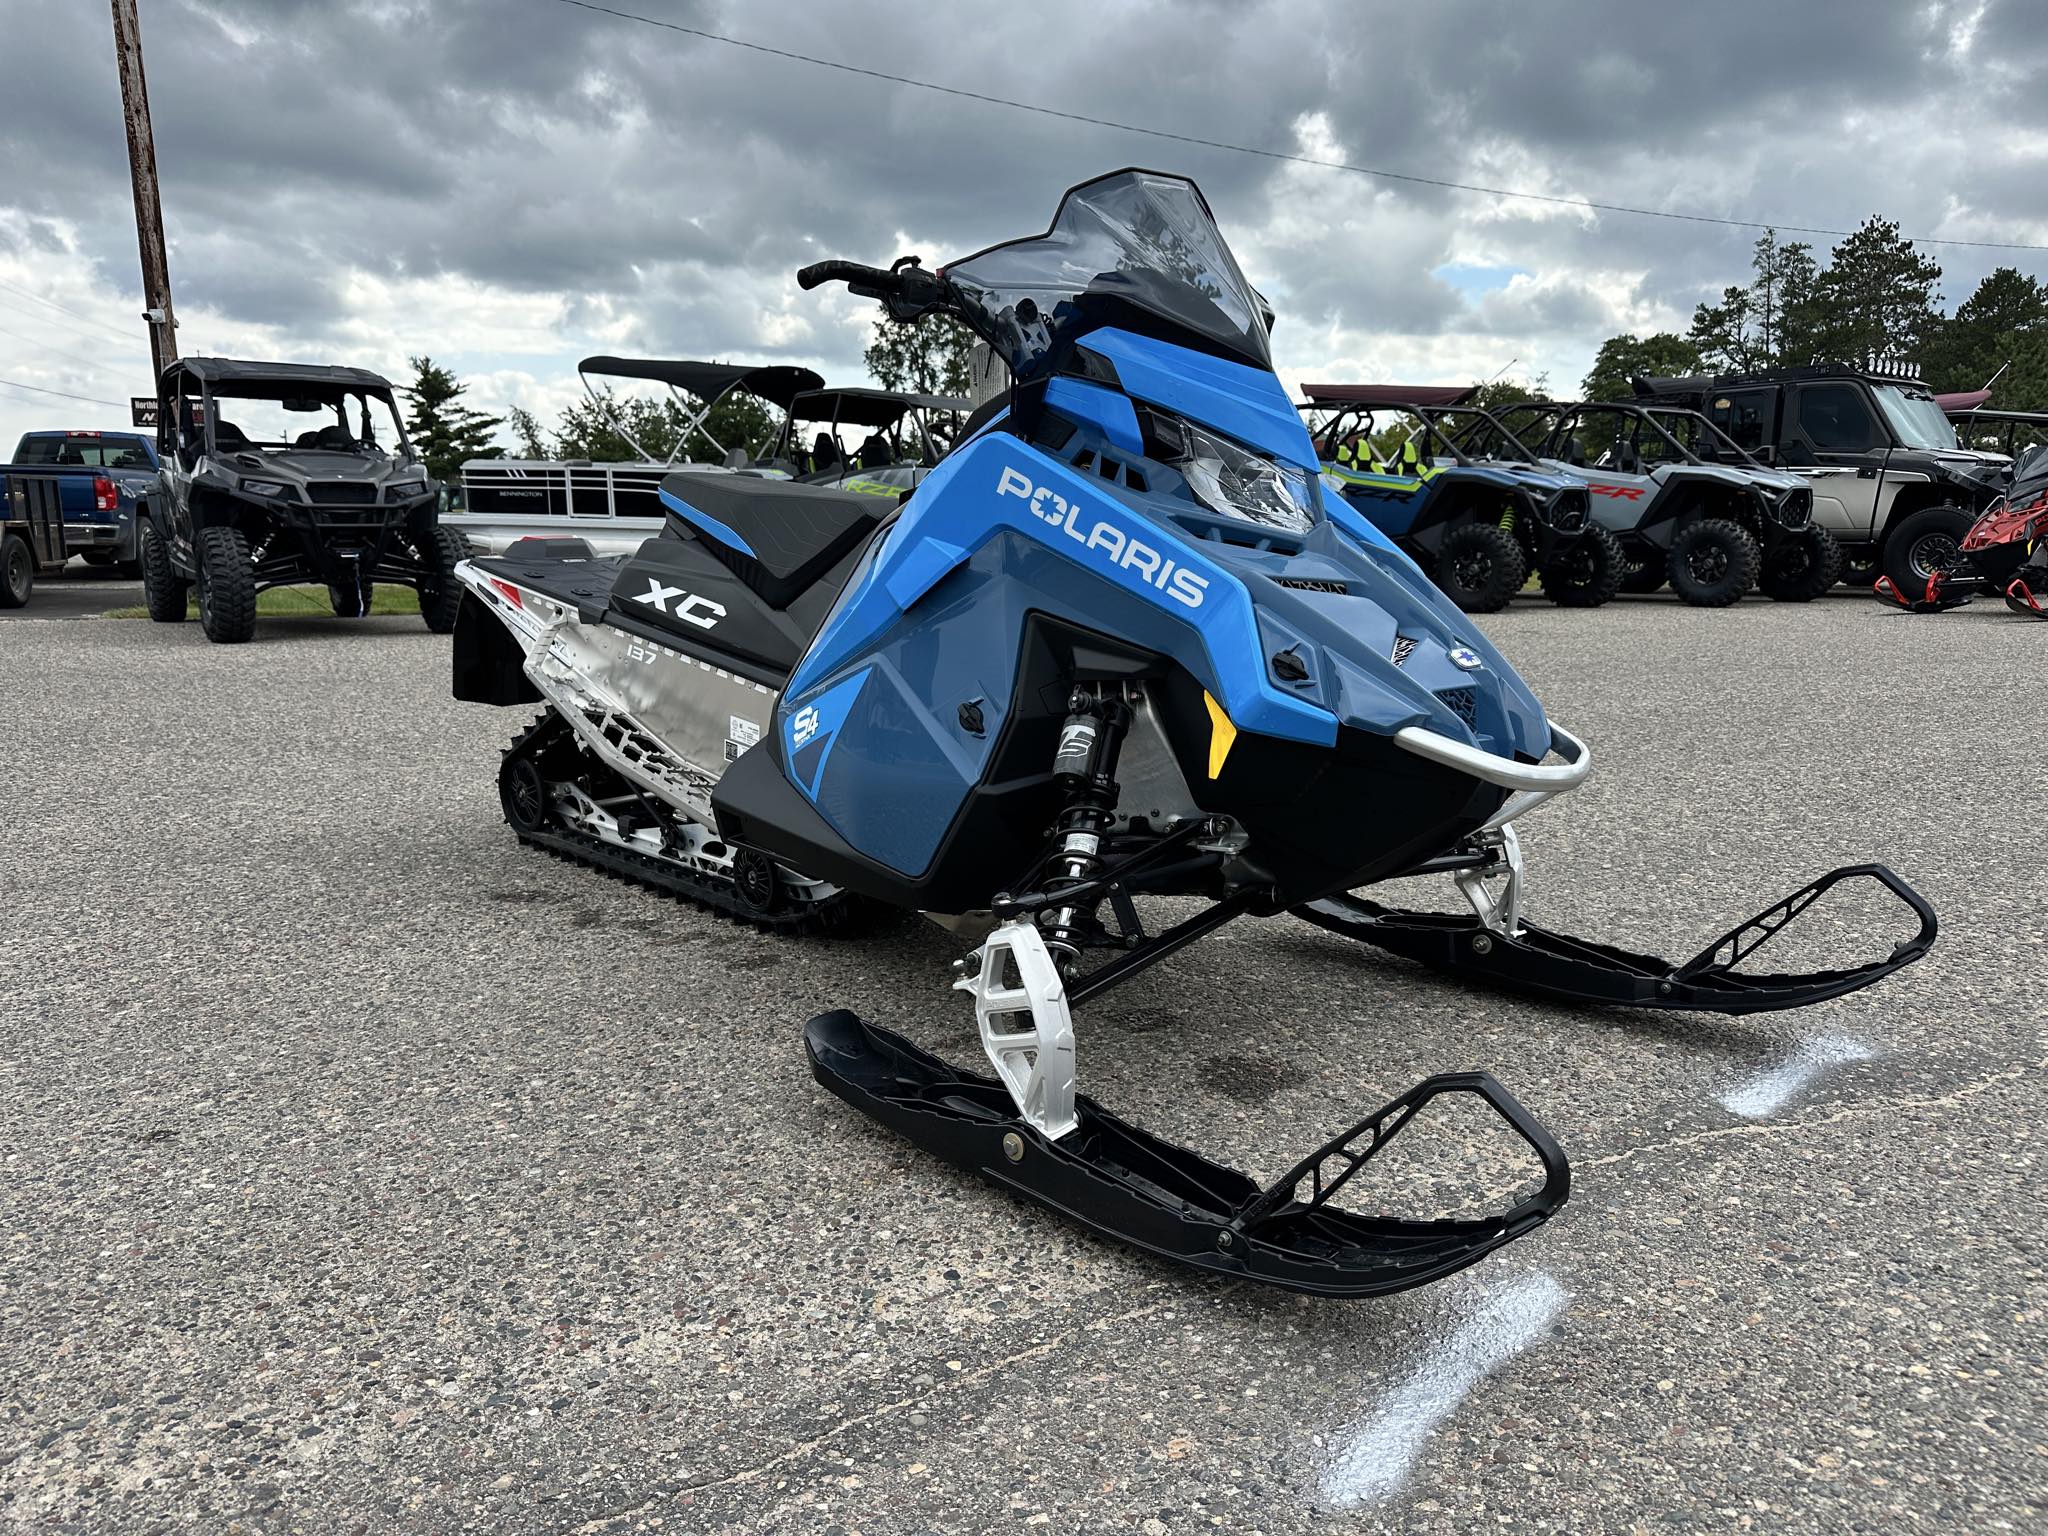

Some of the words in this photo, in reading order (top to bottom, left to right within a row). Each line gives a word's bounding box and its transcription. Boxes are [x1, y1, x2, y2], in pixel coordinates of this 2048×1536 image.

[499, 486, 543, 497] BENNINGTON
[1585, 484, 1645, 501] ZR
[996, 466, 1209, 608] POLARIS
[632, 578, 727, 630] XC
[627, 644, 657, 665] 137
[794, 706, 819, 743] S4
